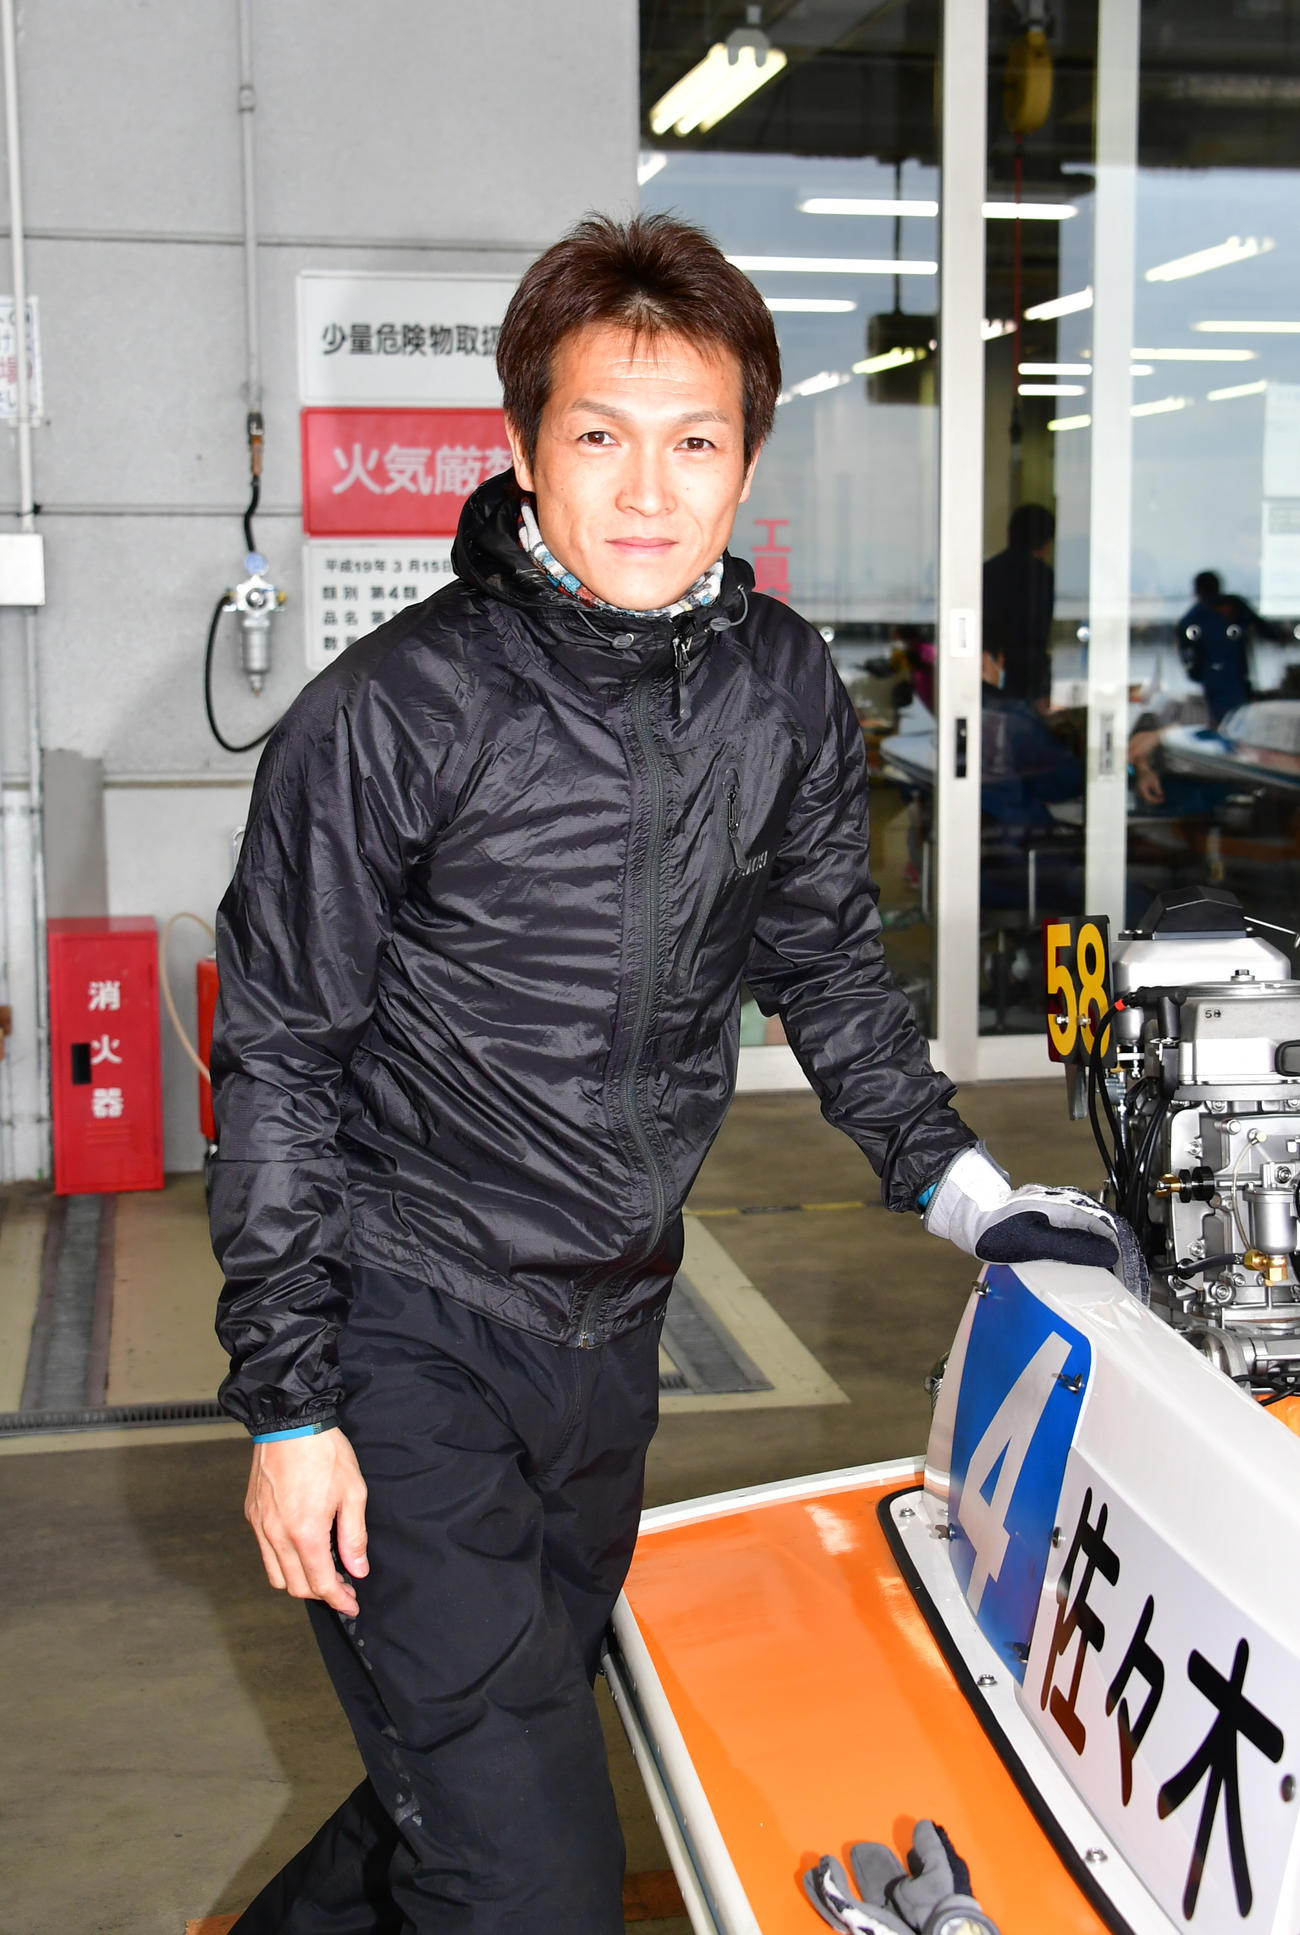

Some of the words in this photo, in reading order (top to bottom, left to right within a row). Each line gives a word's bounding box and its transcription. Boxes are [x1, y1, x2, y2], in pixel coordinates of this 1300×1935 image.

[752, 519, 791, 604] 工具
[88, 980, 124, 1118] 消火器
[1047, 923, 1110, 1058] 58
[957, 1331, 1073, 1615] 4
[1040, 1486, 1285, 1921] 佐々木
